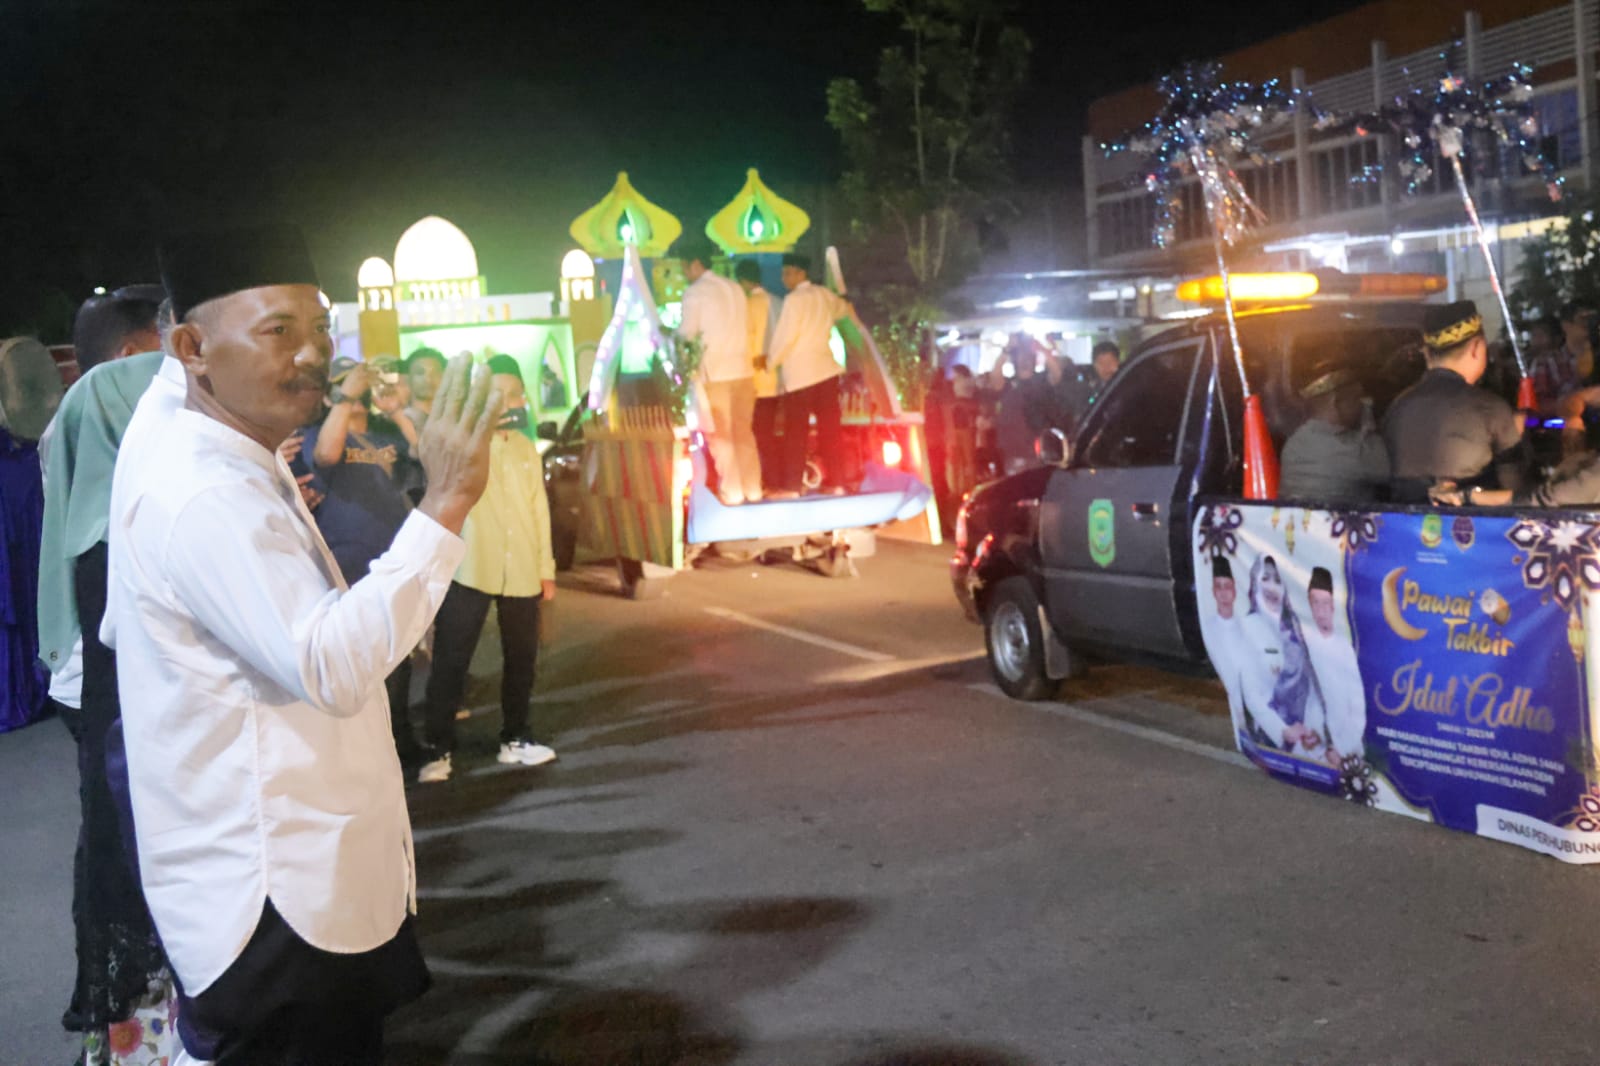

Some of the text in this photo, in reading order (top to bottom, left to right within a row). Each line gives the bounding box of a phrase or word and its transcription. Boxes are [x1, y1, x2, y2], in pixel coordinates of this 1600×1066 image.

[1402, 579, 1475, 617] Pawai
[1443, 618, 1515, 656] Takbir
[1374, 659, 1556, 733] Idul Adha
[1457, 742, 1487, 756] TAKBIR
[1511, 752, 1537, 767] ADHA
[1497, 818, 1530, 838] DINAS
